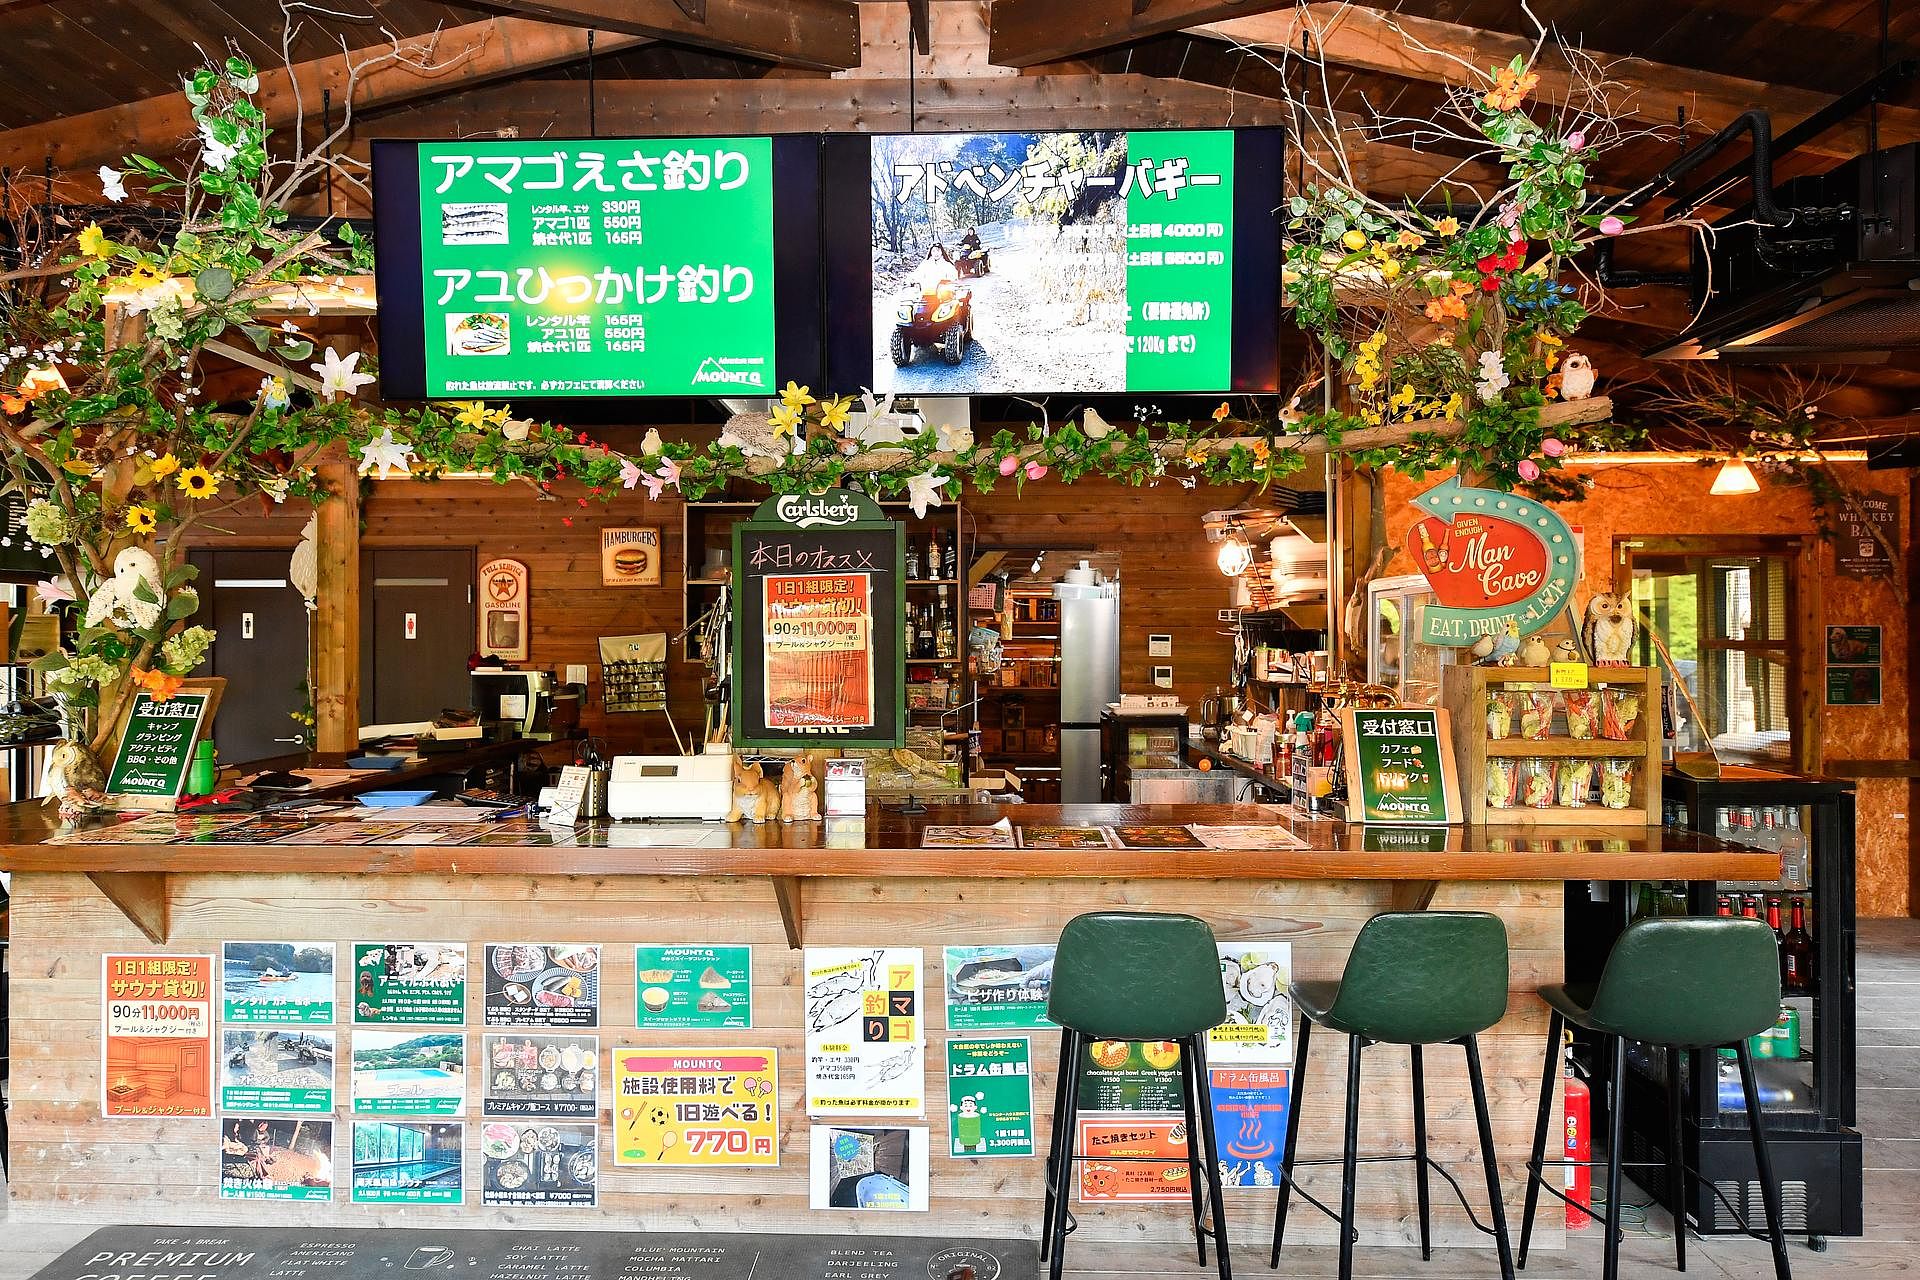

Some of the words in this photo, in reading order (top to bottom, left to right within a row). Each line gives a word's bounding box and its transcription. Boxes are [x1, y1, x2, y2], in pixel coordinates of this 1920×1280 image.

[431, 150, 750, 195] アマゴえさ釣り
[894, 159, 1222, 203] アドベンチャーバギー
[433, 264, 754, 306] アユひっかけ釣り
[776, 495, 859, 527] Carlsberg
[1457, 518, 1479, 528] GIVEN
[1455, 526, 1484, 537] ENOUGH
[604, 531, 657, 549] HAMBURGERS
[1449, 532, 1515, 572] Man
[1478, 564, 1541, 596] Cave
[1430, 617, 1467, 640] EAT,
[138, 701, 200, 717] 受付窓口
[147, 722, 180, 731] キャンプ
[1363, 718, 1434, 735] 受付窓口
[1380, 744, 1410, 754] カフェ
[1381, 758, 1412, 769] フード
[114, 961, 198, 976] 1日1組限定!
[111, 980, 207, 998] サウナ貸切!
[967, 988, 1044, 1003] ピザ作り体験
[112, 1004, 200, 1021] 90分11,000円
[623, 1076, 736, 1095] 施設使用料で
[1219, 1072, 1280, 1083] ドラム缶風呂
[1091, 1129, 1157, 1146] たこ焼きセット
[153, 1238, 178, 1246] TAKE
[84, 1251, 256, 1267] PREMIUM
[827, 1260, 899, 1268] DARJEELING
[936, 1251, 989, 1264] ORIGINAL
